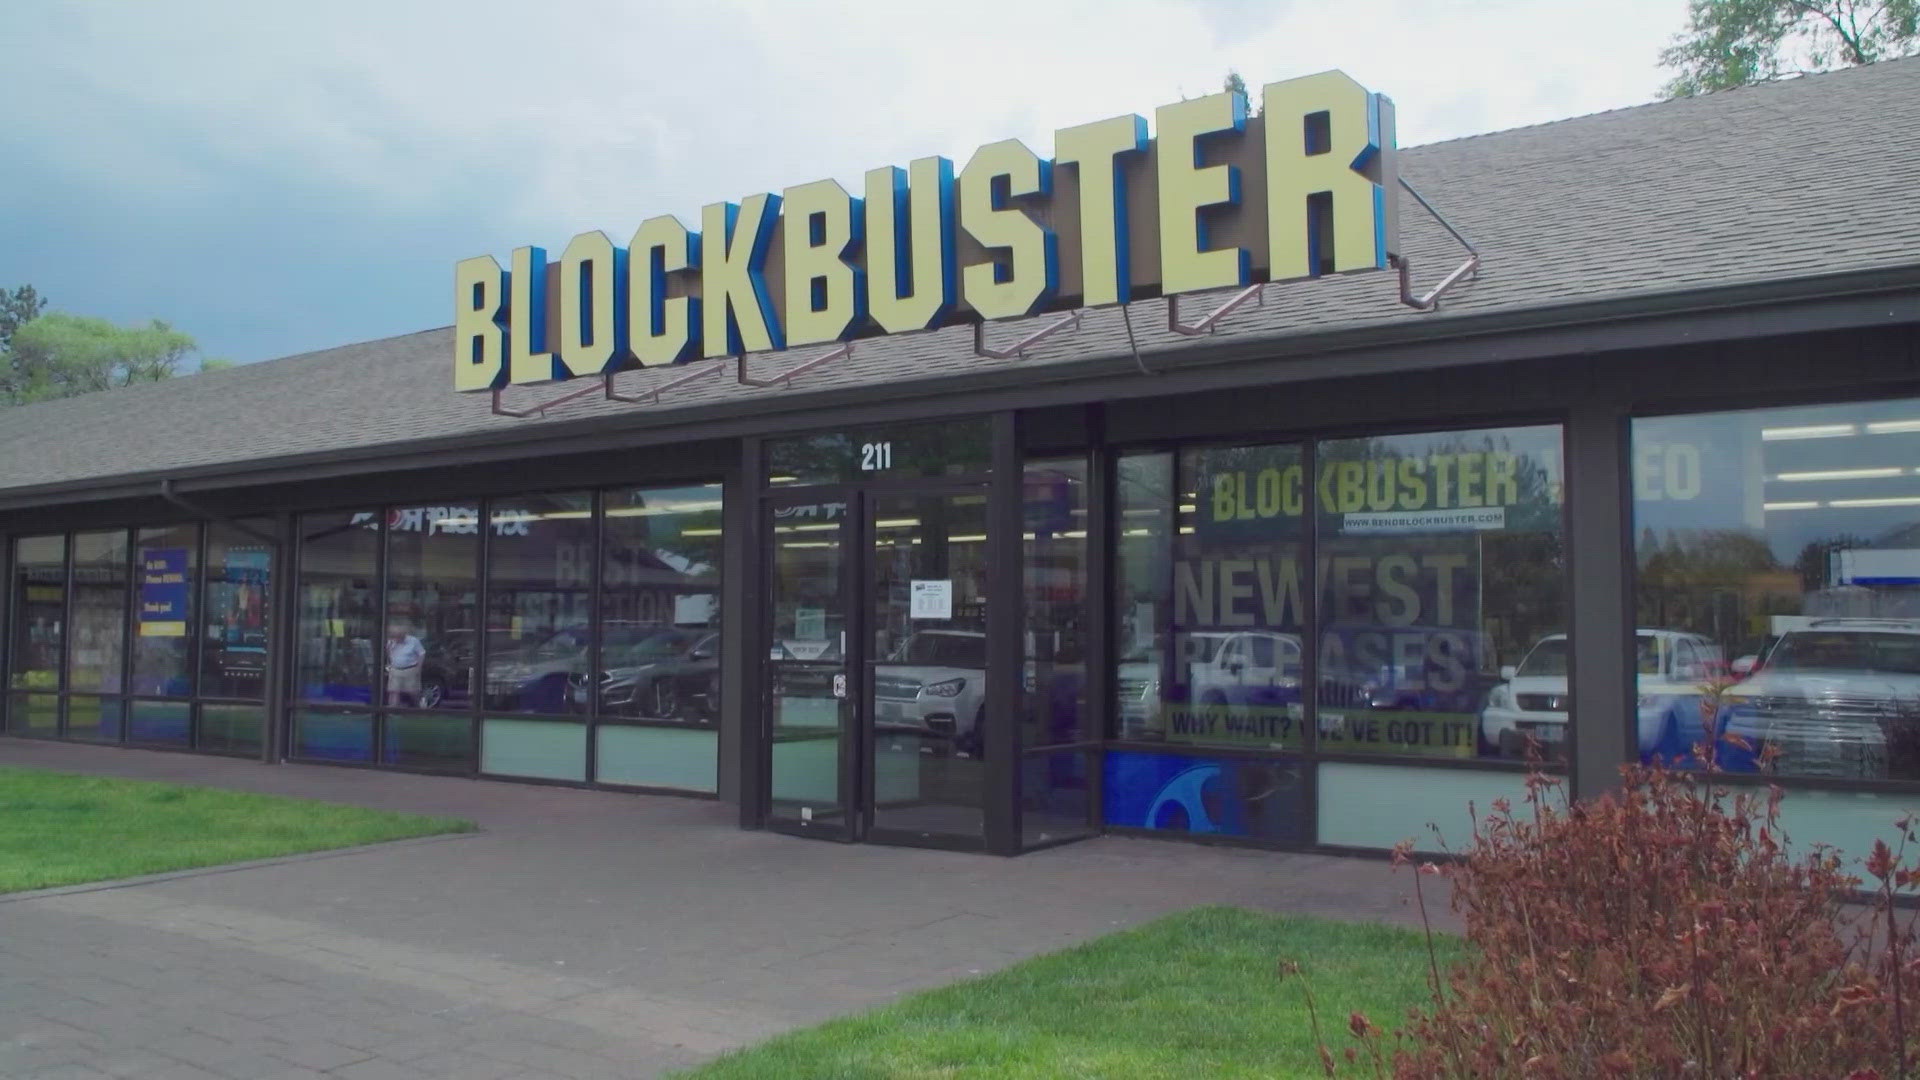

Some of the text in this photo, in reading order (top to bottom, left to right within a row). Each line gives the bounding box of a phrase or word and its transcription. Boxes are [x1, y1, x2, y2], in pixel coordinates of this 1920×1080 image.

[455, 69, 1386, 393] BLOCKBUSTER
[861, 442, 892, 471] 211
[1212, 451, 1518, 522] BLOCKBUSTER
[1344, 514, 1504, 528] WWW.BENDBLOCKBUSTER.COM
[1173, 553, 1468, 628] NEWEST
[1174, 631, 1467, 692] REASES
[1172, 713, 1218, 736] WHY
[1225, 715, 1292, 739] WAIT?
[1387, 720, 1434, 746] GOT
[1442, 722, 1473, 747] IT!
